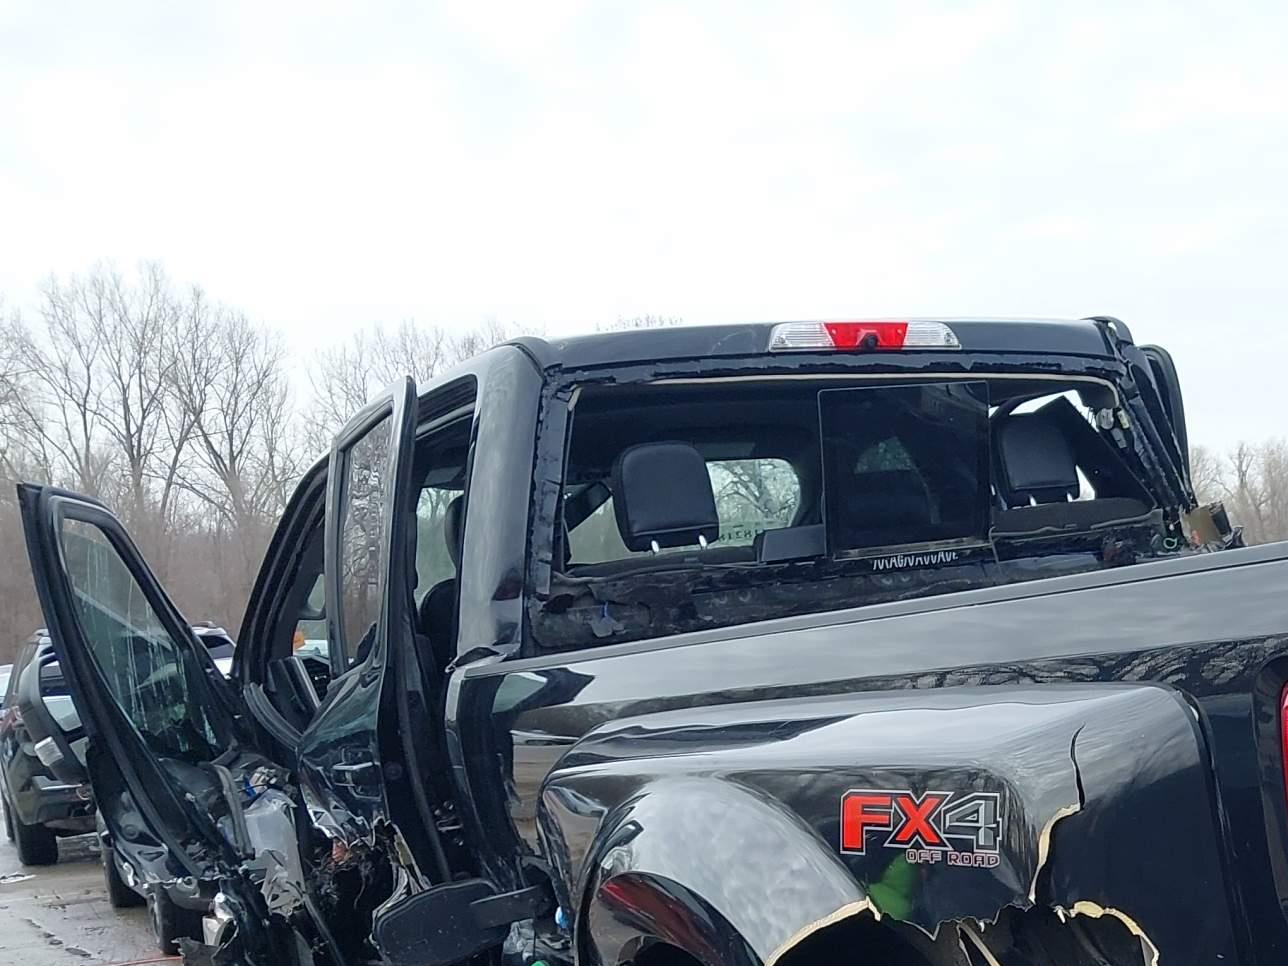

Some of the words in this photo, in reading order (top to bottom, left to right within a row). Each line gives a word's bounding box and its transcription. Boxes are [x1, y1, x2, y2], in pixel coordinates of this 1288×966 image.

[840, 788, 1003, 855] FX4
[905, 848, 943, 864] OFF
[947, 851, 1000, 868] ROAD
